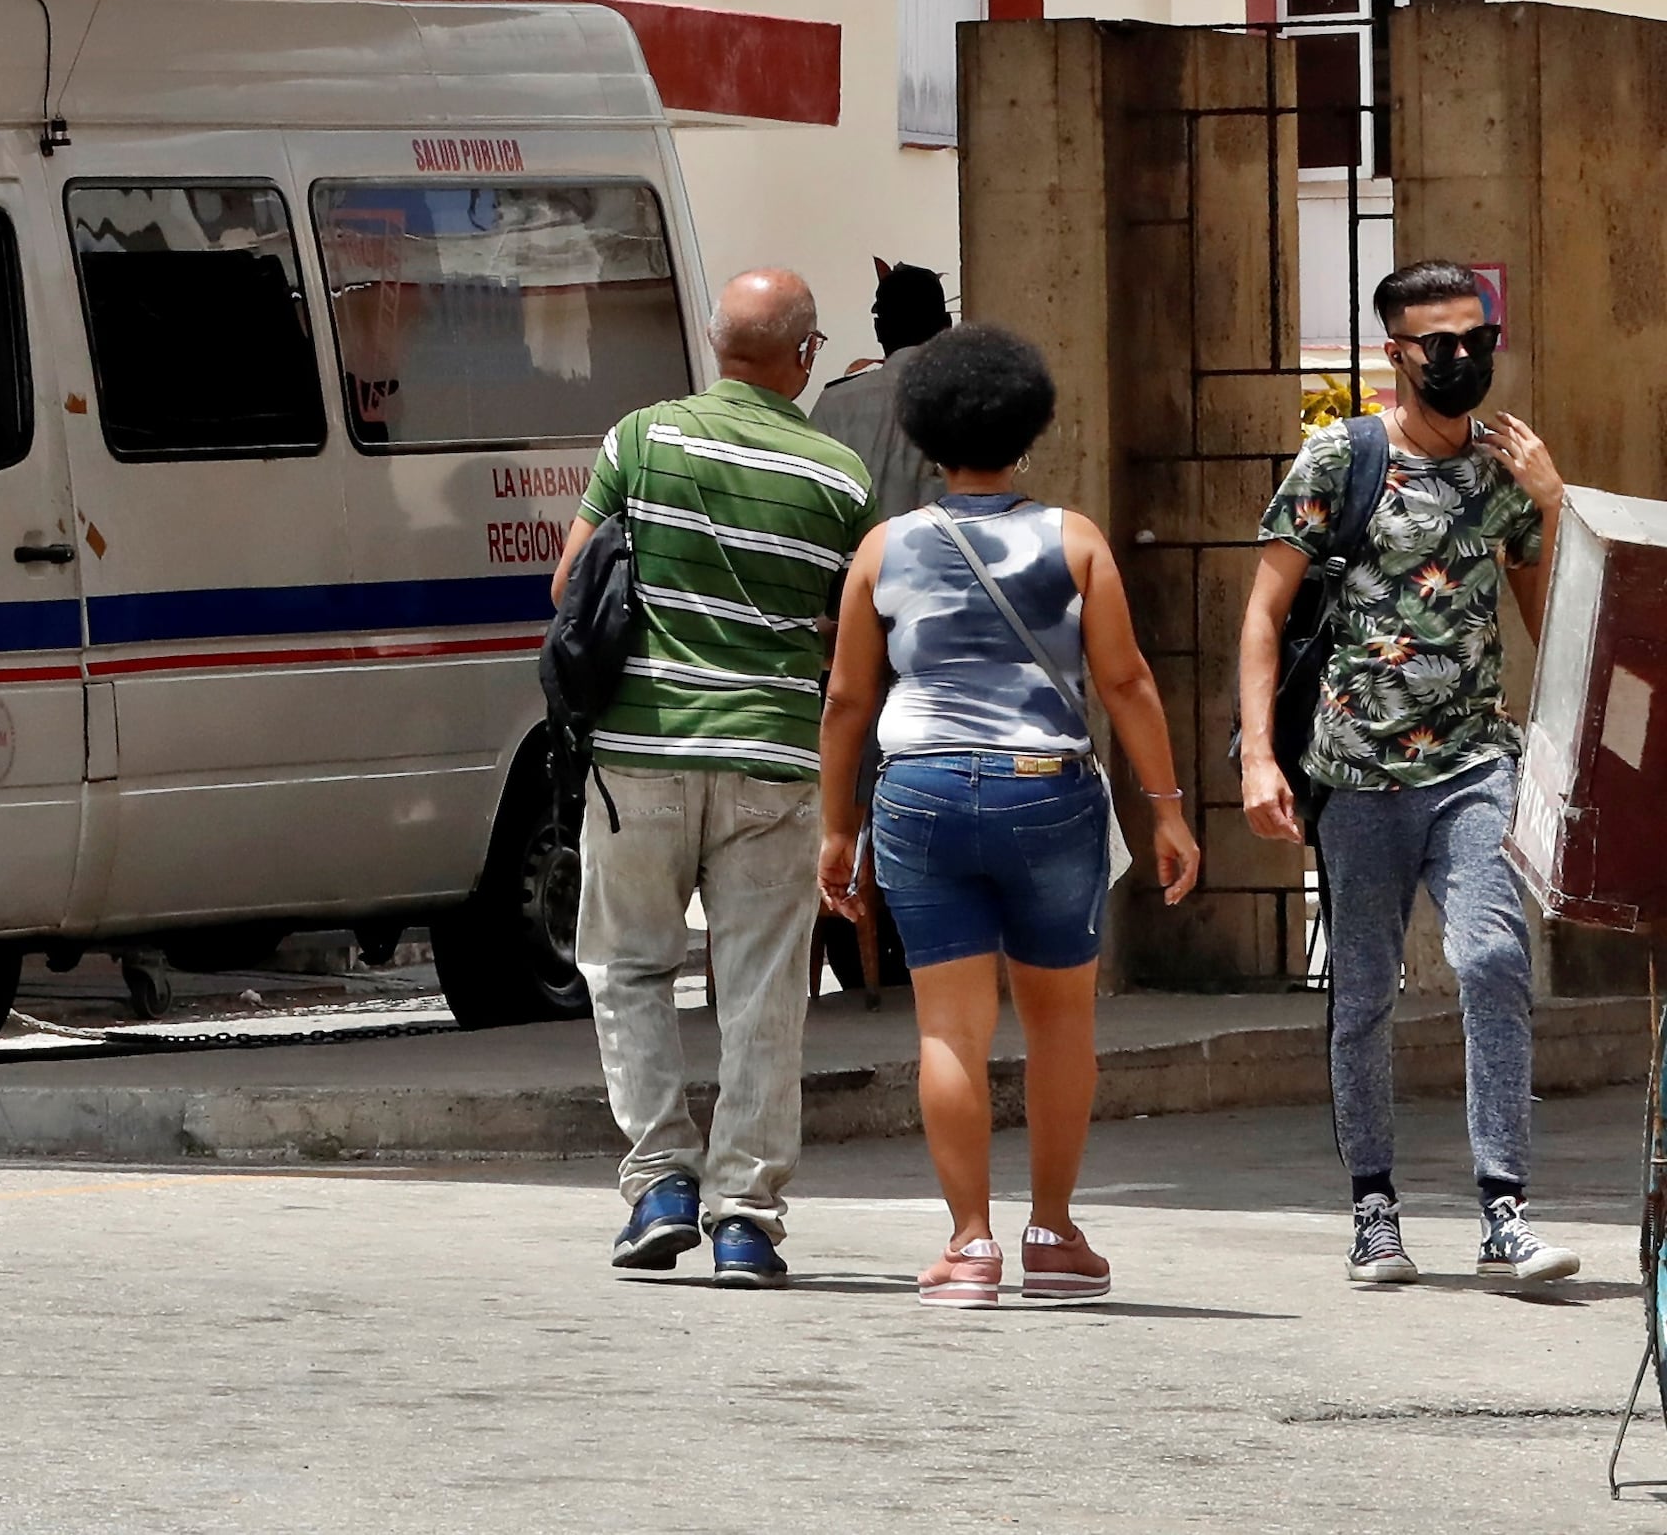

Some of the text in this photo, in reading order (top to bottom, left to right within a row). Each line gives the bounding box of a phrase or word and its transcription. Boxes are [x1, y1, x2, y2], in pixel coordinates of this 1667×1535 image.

[412, 139, 524, 171] SALUD PUBLICA
[492, 468, 516, 497] LA
